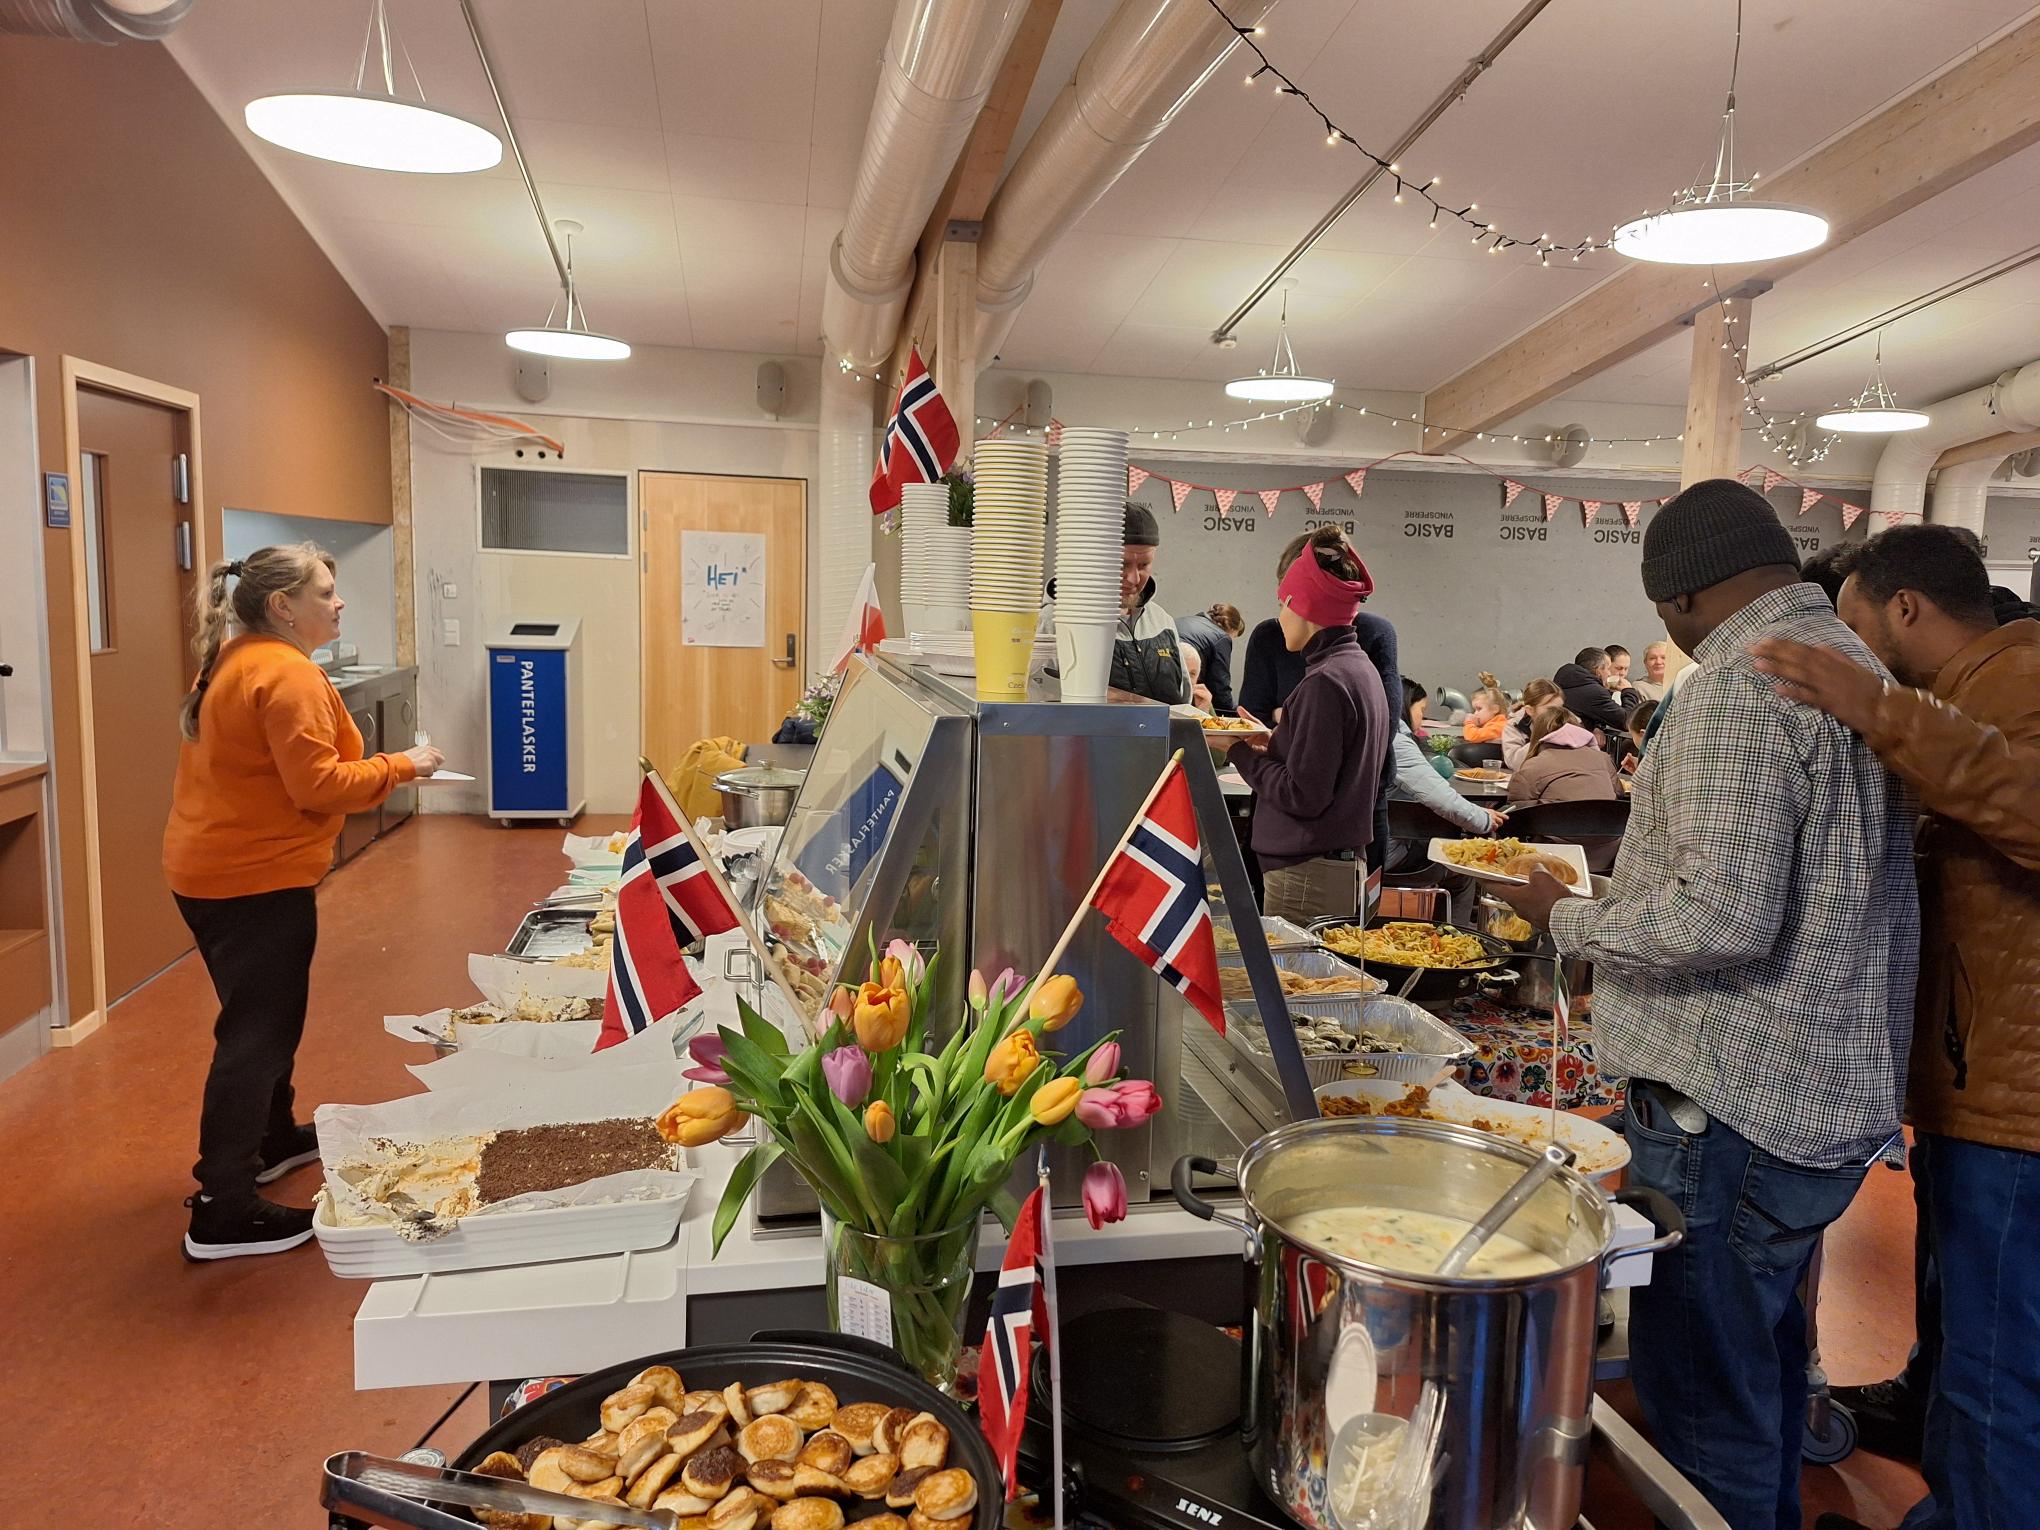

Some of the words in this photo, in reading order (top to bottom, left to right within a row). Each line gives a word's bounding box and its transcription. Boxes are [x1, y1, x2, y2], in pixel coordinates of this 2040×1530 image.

[1204, 503, 1255, 513] VINDSRRE
[1404, 510, 1454, 519] VINDSPERRE
[1203, 517, 1255, 532] BASIC
[1404, 523, 1454, 538] BASIC
[1500, 526, 1548, 541] BASIC
[1594, 529, 1641, 544] BASIC
[520, 661, 536, 773] PANTEFLASKER
[1175, 1497, 1223, 1526] SENZ
